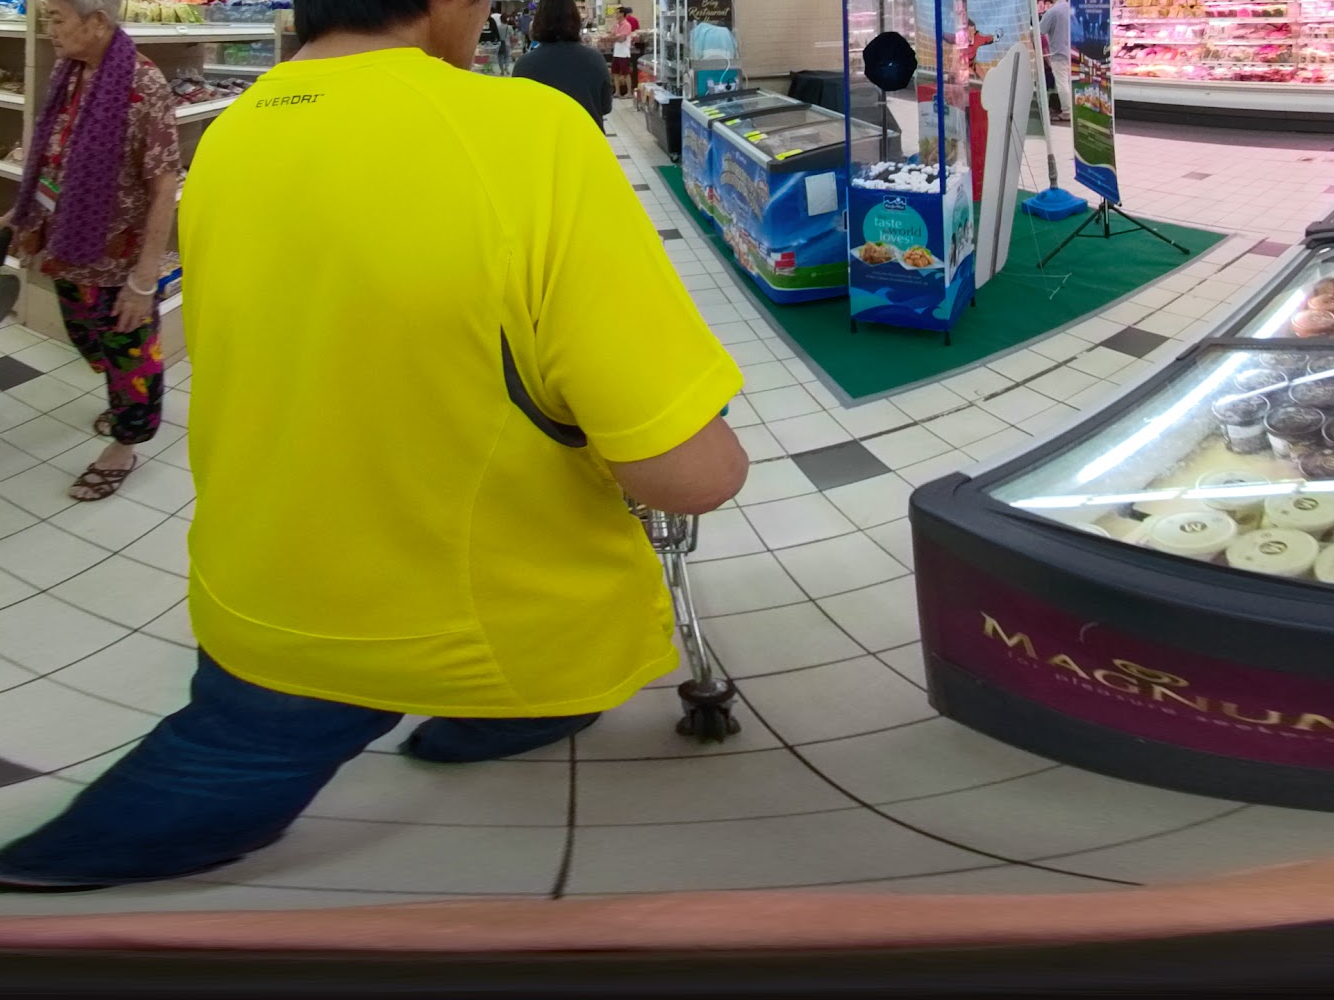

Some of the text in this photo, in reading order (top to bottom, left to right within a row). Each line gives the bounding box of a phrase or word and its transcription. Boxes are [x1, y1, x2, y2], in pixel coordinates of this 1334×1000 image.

[875, 217, 902, 228] taste
[880, 230, 914, 244] loves!
[888, 226, 922, 237] world
